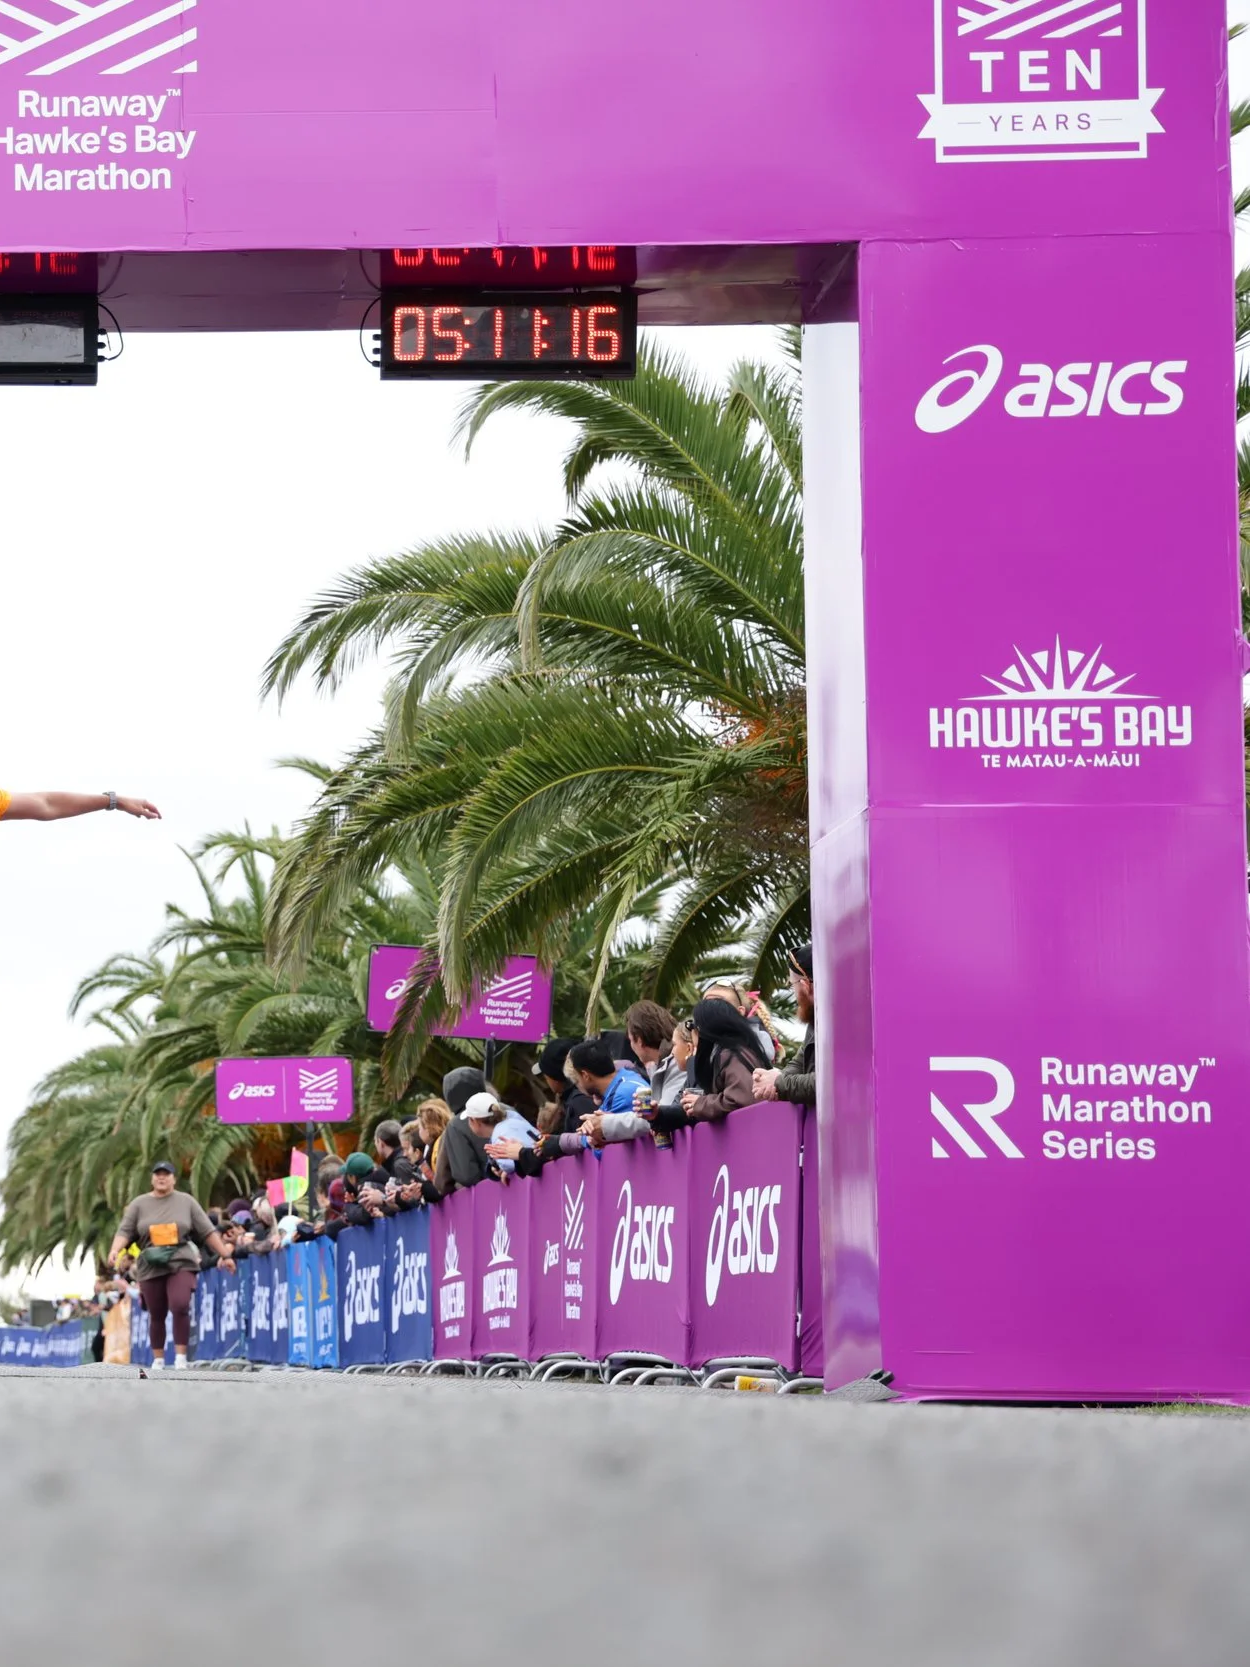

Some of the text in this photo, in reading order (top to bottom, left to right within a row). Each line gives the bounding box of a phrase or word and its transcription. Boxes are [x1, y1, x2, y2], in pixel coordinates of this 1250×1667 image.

[969, 48, 1101, 93] TEN
[989, 112, 1091, 132] YEARS
[134, 124, 197, 160] Bay
[14, 162, 172, 191] Marathon
[393, 305, 621, 363] 05:11:16
[929, 705, 1192, 748] HAWKE'S BAY
[981, 750, 1140, 768] TE MATAU-A-MĀUI
[485, 1016, 524, 1027] Marathon
[1042, 1093, 1212, 1123] Marathon
[1042, 1130, 1156, 1160] Series
